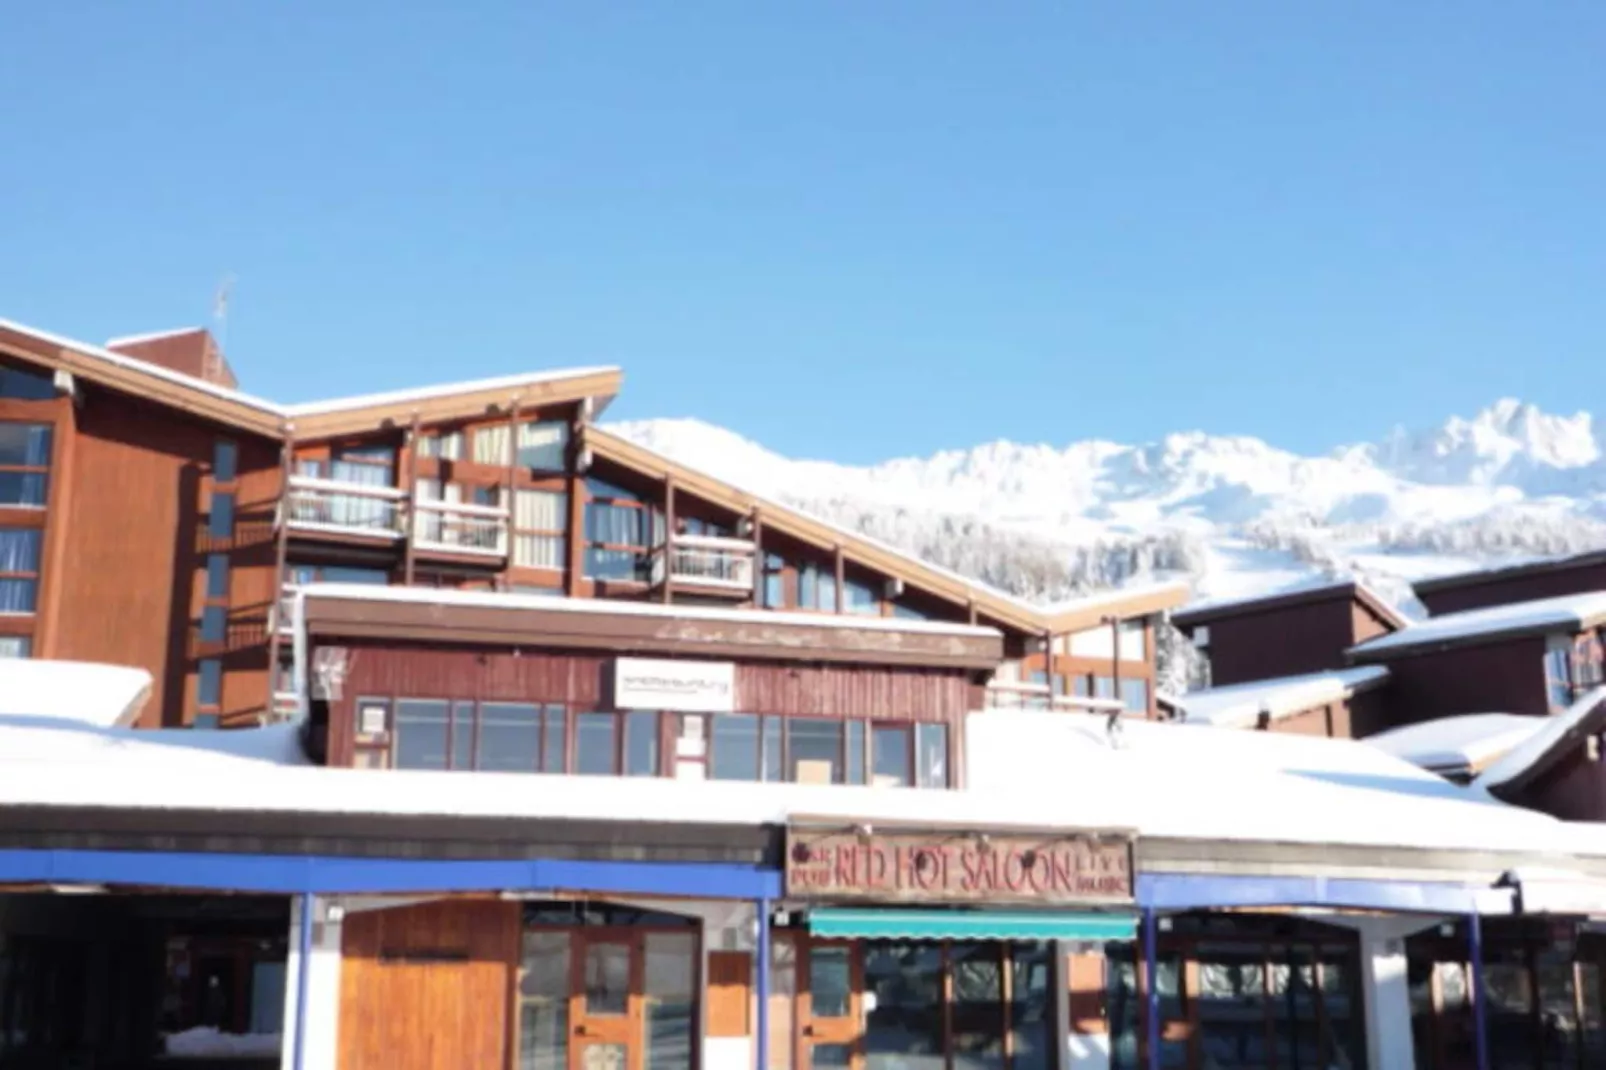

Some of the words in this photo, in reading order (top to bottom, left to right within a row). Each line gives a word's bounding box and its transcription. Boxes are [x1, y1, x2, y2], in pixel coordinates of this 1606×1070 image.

[836, 843, 886, 888] RED
[895, 844, 951, 890] HOT
[960, 846, 1072, 893] SALOON
